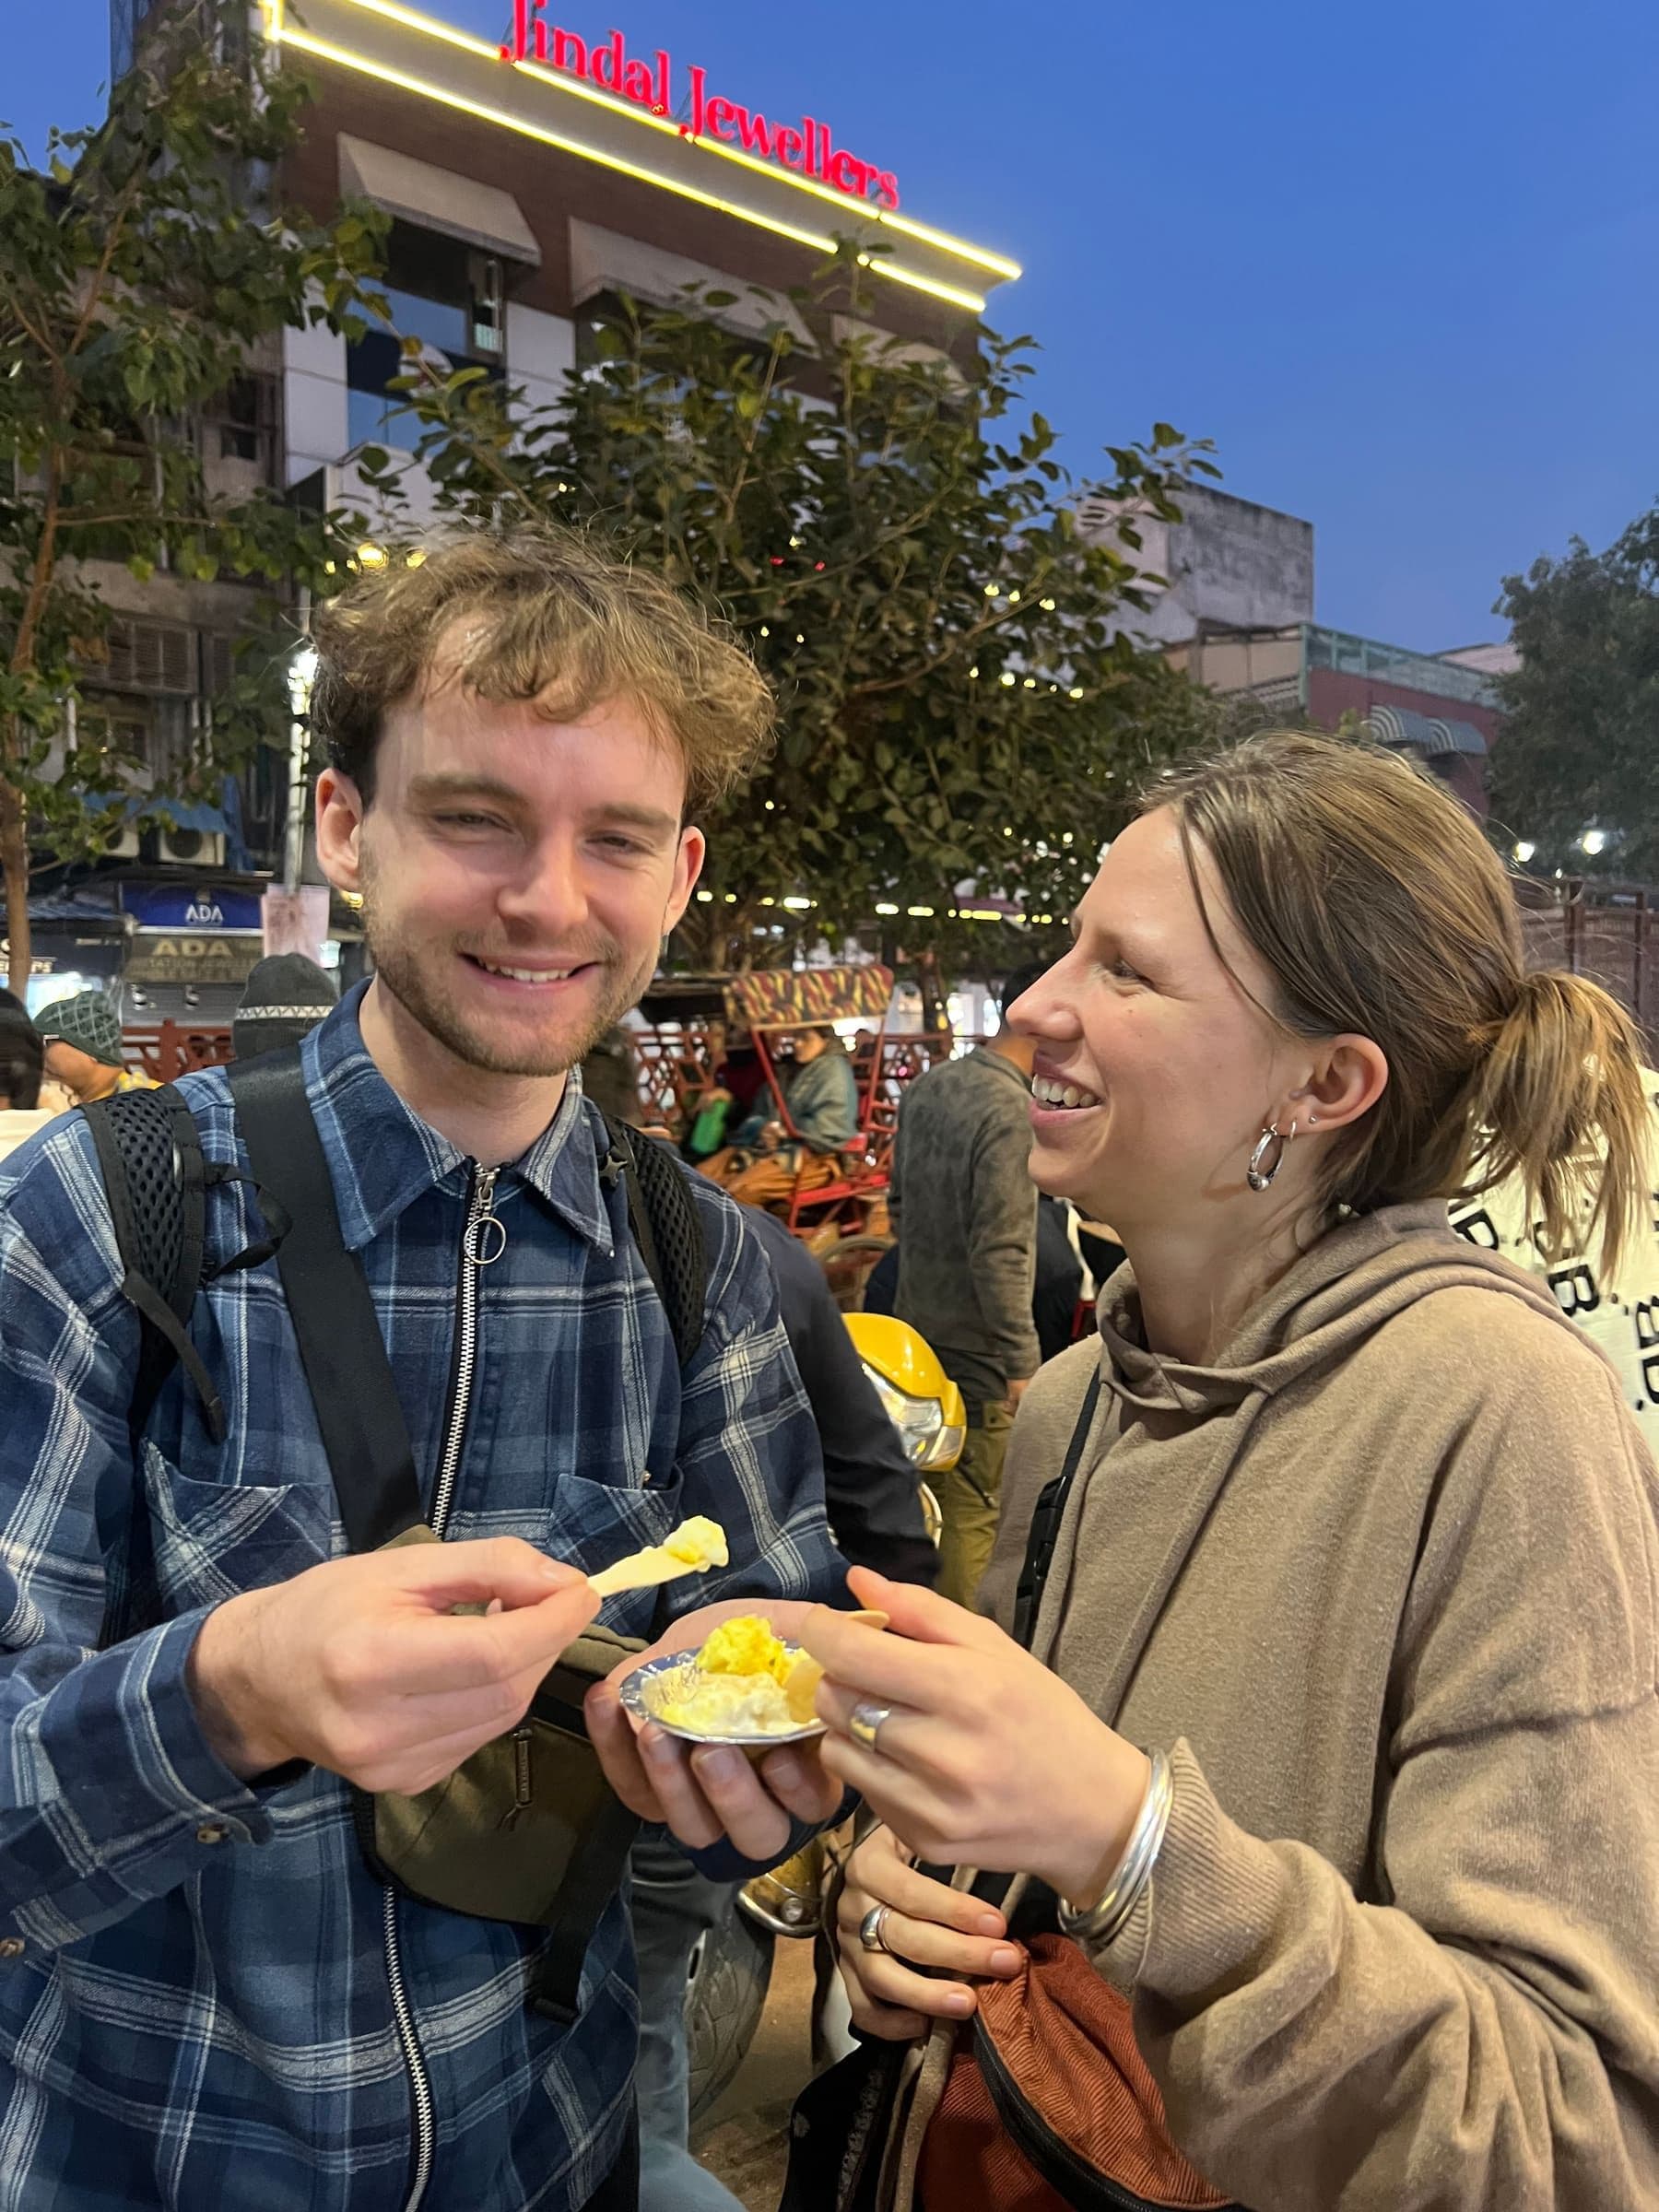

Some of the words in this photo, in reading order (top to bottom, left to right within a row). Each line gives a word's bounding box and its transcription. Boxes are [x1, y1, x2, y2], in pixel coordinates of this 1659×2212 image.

[500, 0, 670, 116] Jindal
[679, 65, 899, 210] Jewellers
[185, 904, 223, 922] ADA
[153, 938, 232, 958] ADA
